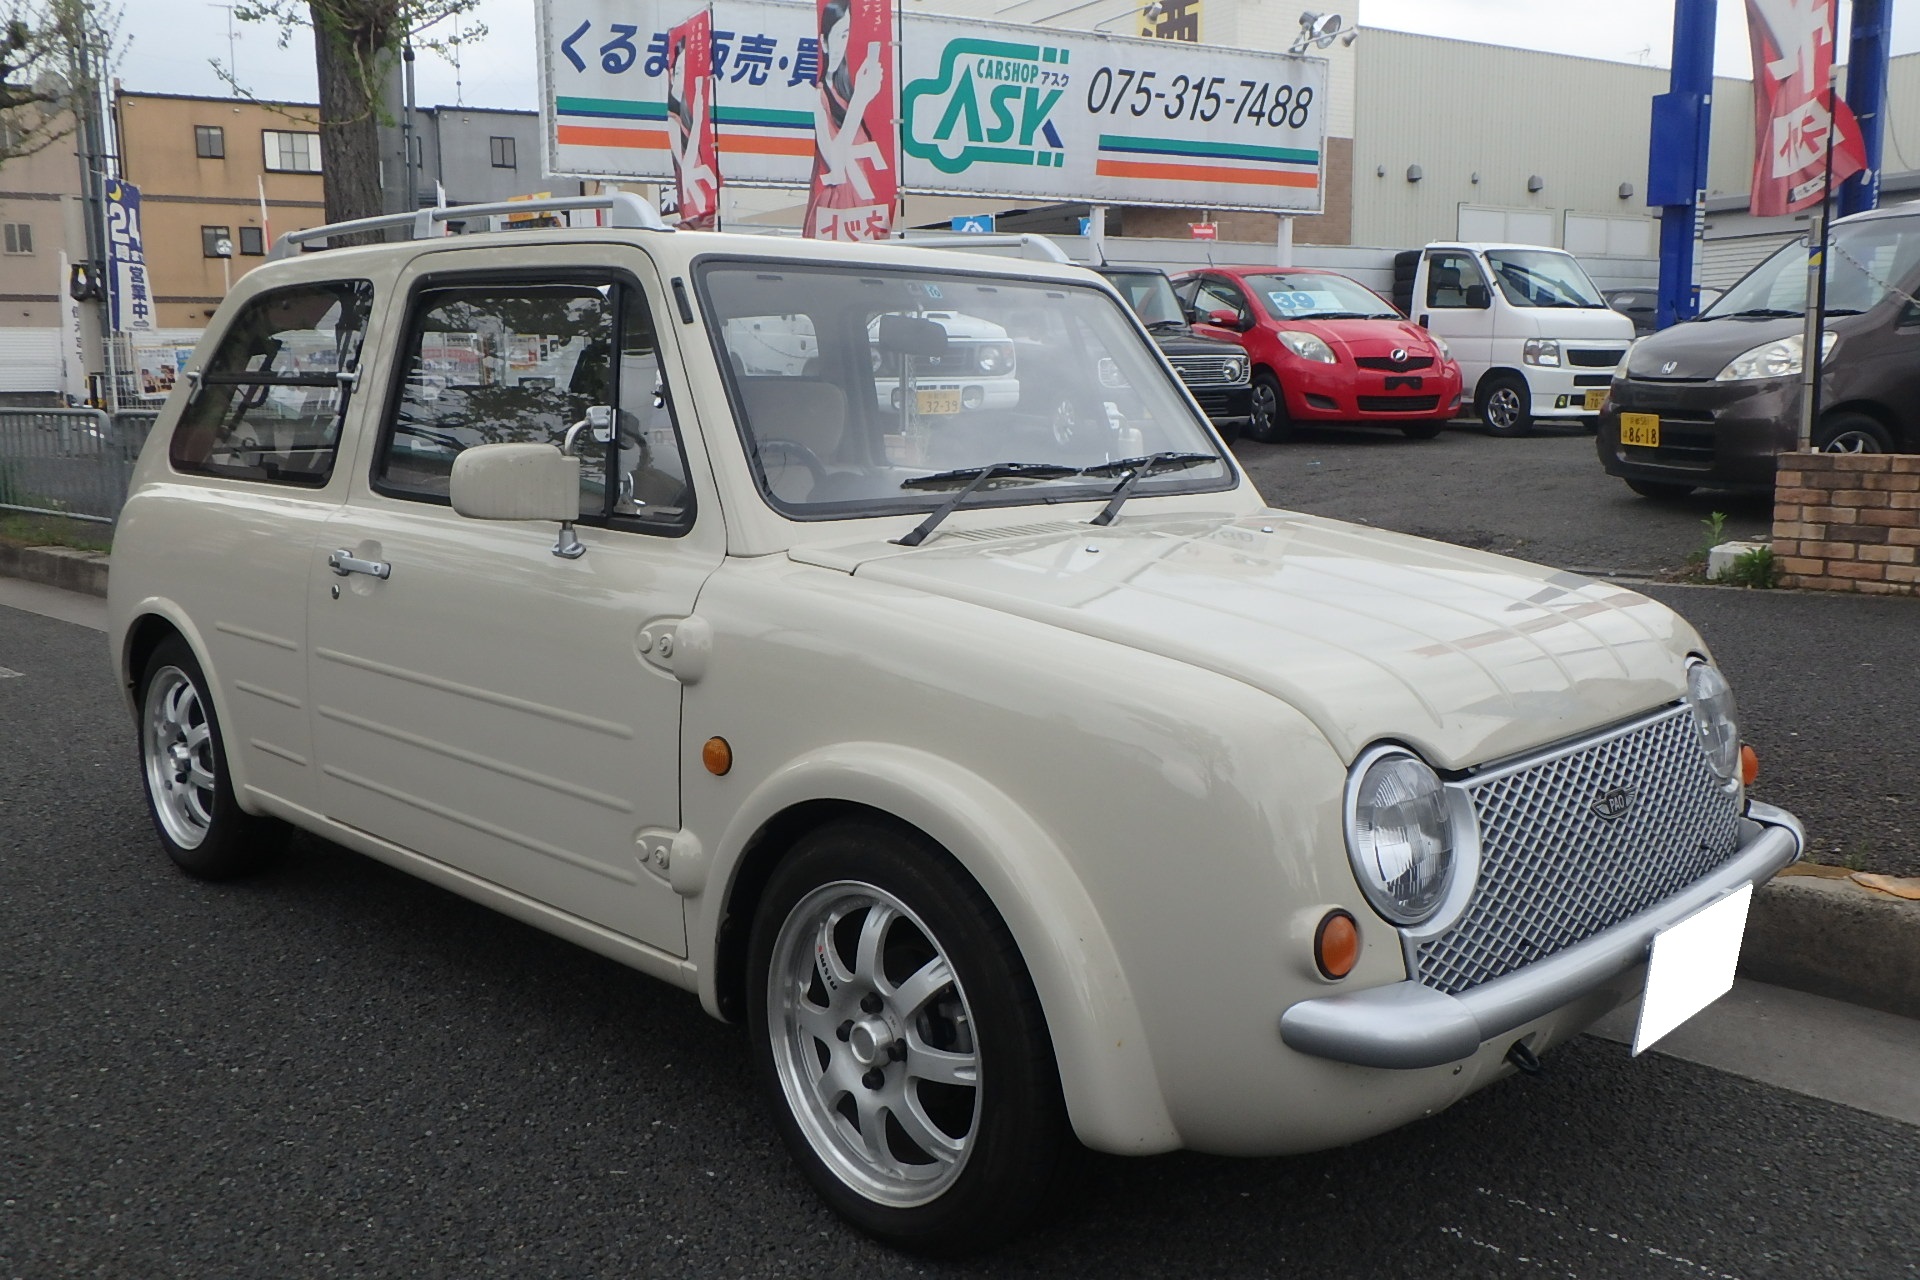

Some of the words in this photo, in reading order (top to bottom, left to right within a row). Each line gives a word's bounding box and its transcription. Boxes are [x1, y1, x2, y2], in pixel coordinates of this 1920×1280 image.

[976, 58, 1039, 84] CARSHOP
[1041, 71, 1070, 87] アスク
[932, 64, 1064, 148] ASK
[1086, 66, 1314, 129] 075-315-7488
[110, 202, 141, 247] 24
[129, 266, 149, 319] 営業中
[1272, 292, 1316, 309] 39
[1629, 427, 1656, 444] 86-18
[1609, 795, 1624, 812] PAO
